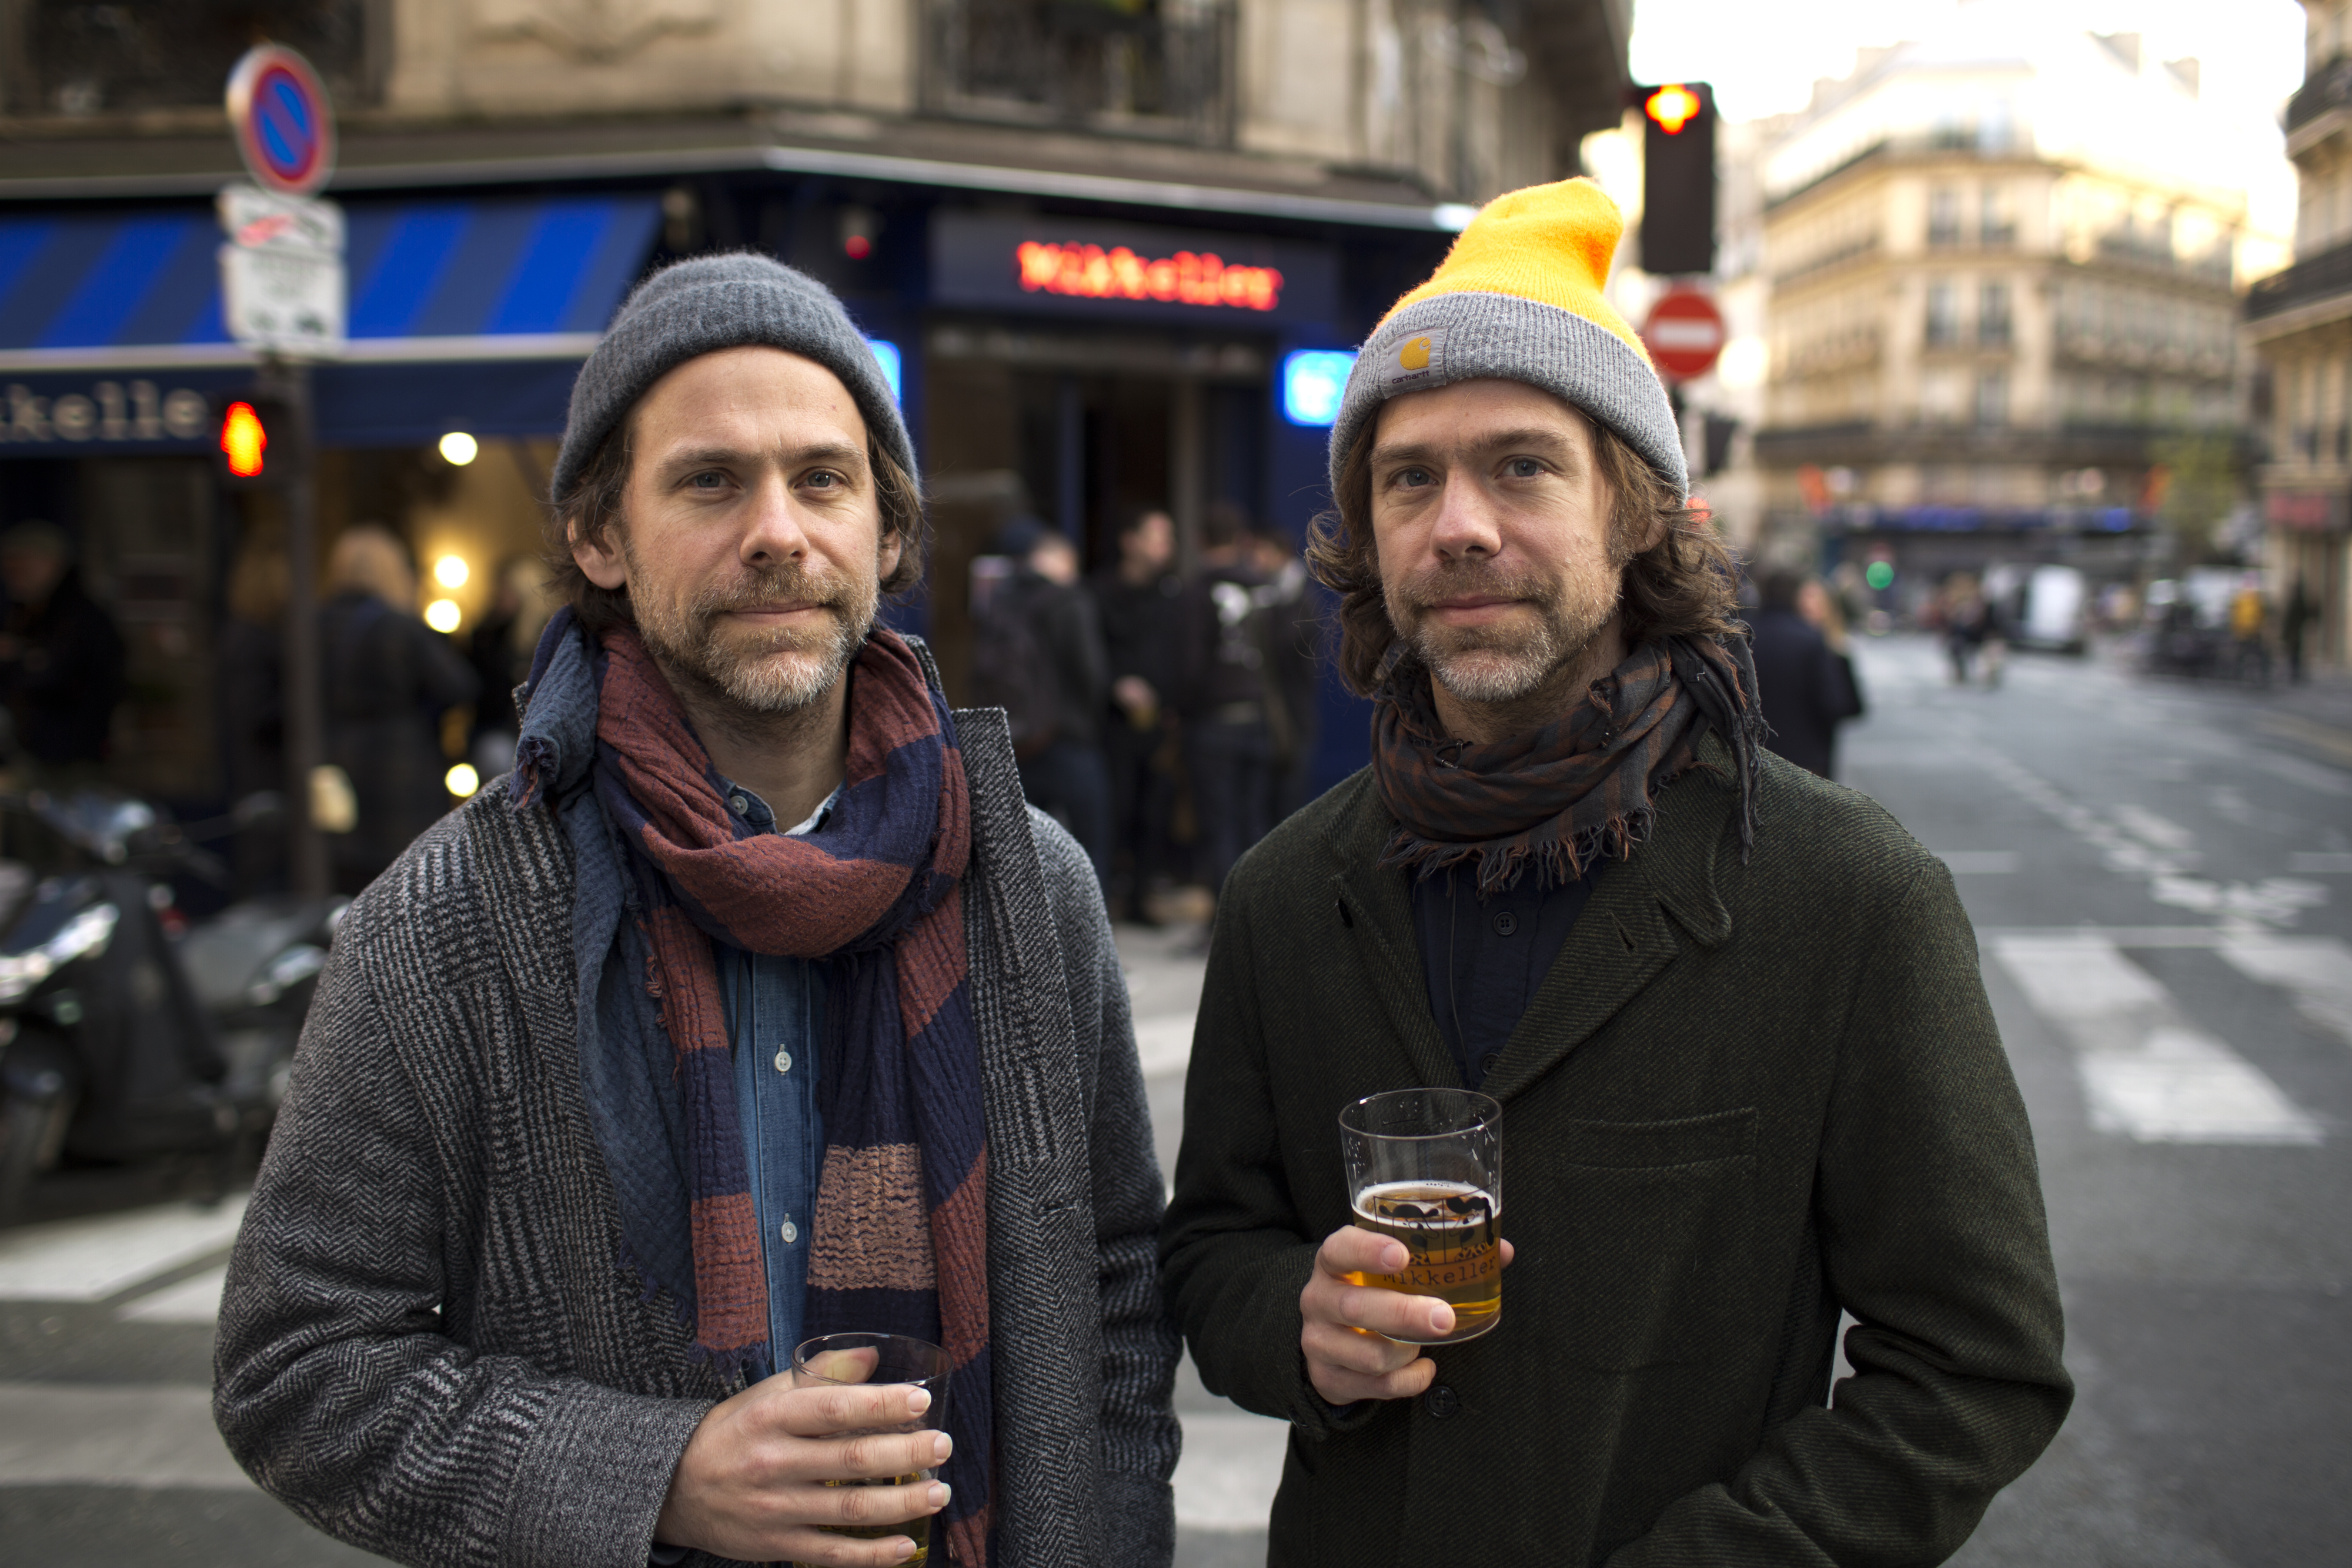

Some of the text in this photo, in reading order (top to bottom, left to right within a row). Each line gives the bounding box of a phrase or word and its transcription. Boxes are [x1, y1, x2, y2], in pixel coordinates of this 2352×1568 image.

[1392, 370, 1429, 384] carhartt
[0, 379, 220, 442] kelle
[1383, 1255, 1496, 1286] Mikkeller
